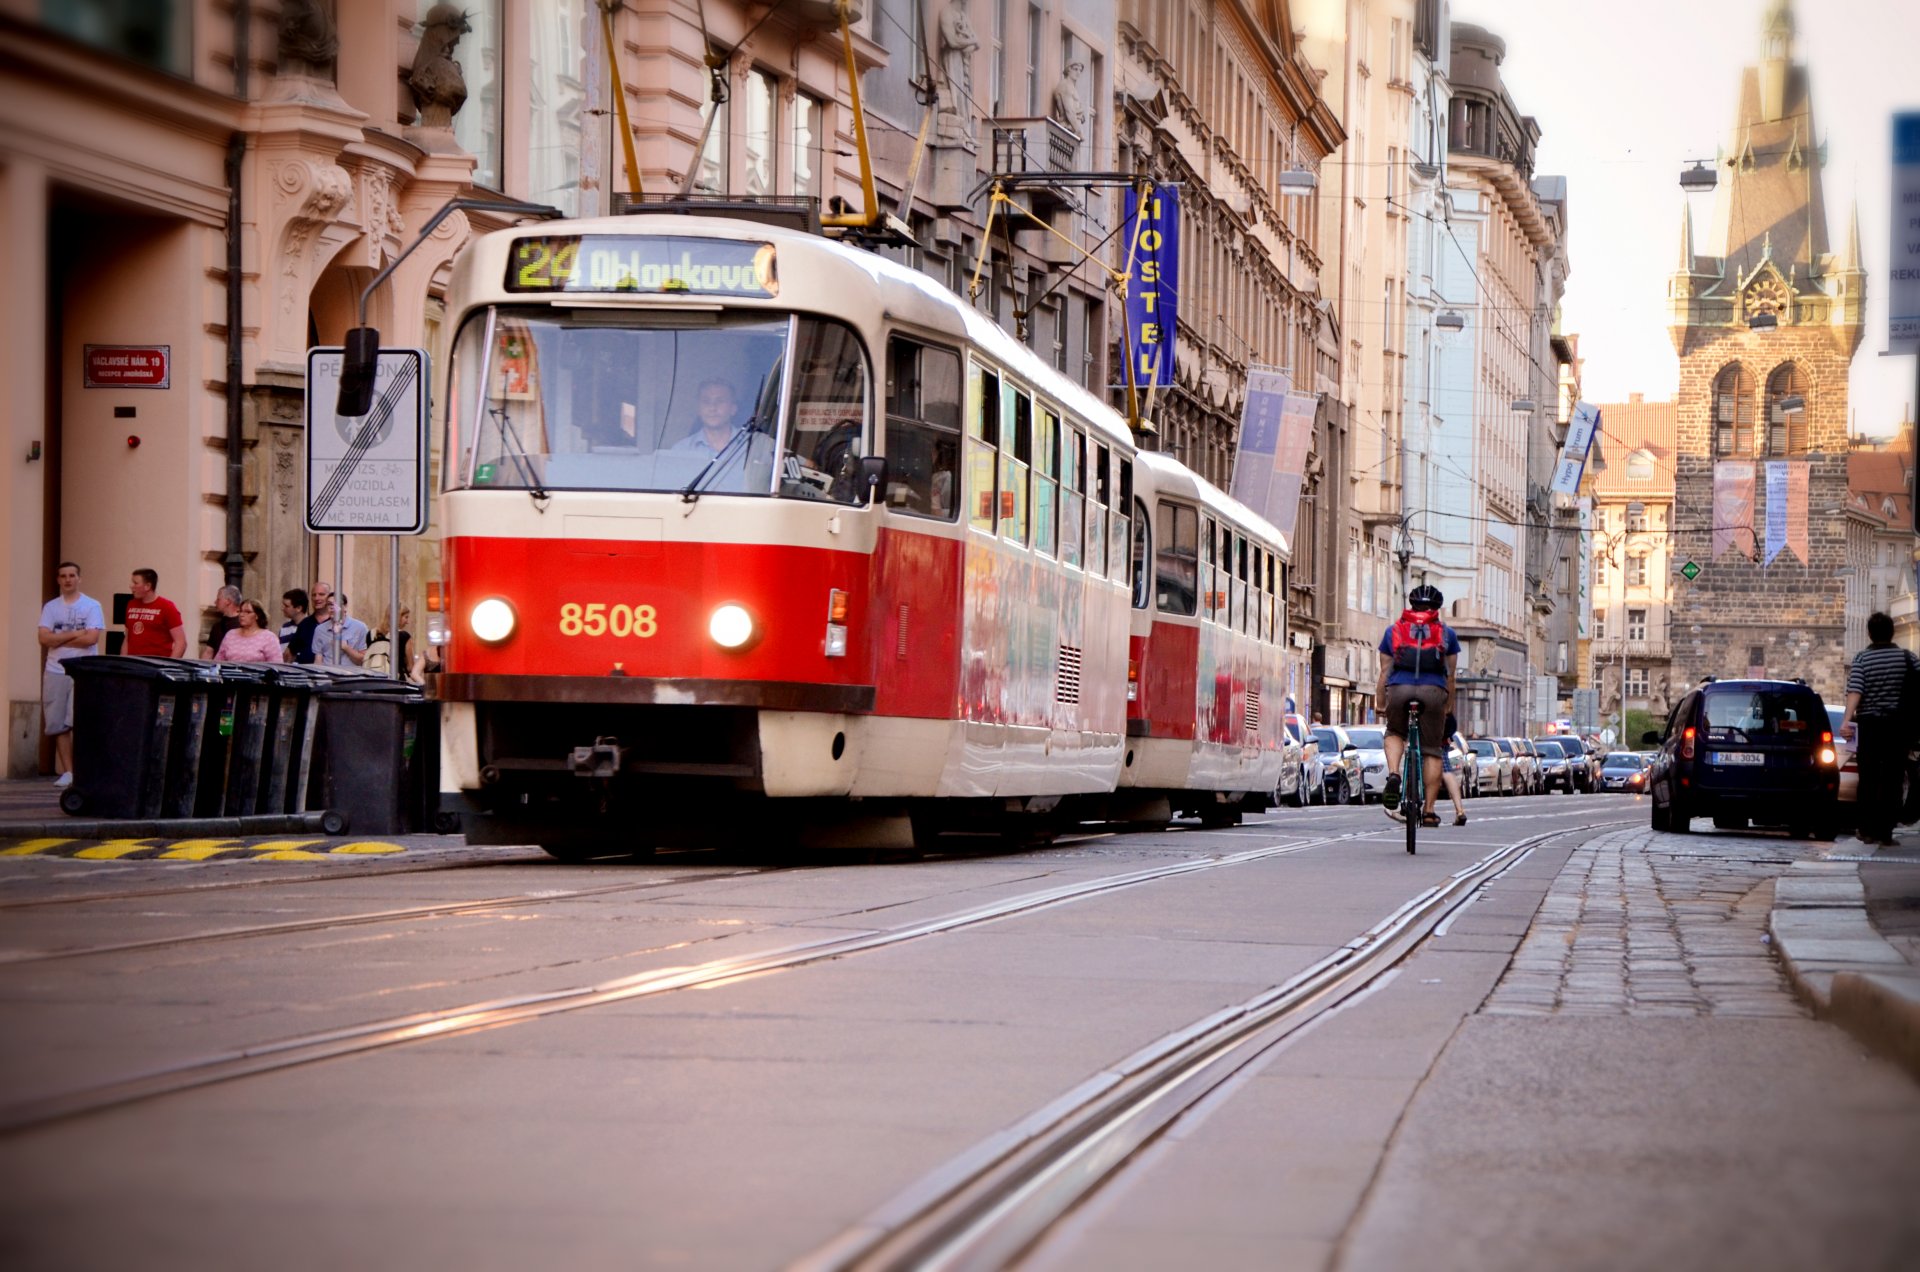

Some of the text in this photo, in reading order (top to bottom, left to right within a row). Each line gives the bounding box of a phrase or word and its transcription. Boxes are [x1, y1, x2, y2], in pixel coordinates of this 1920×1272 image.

[519, 242, 582, 288] 24
[151, 356, 160, 367] 19
[338, 496, 410, 508] SOUHLASEM
[350, 512, 390, 524] PRAHA
[559, 602, 658, 638] 8508
